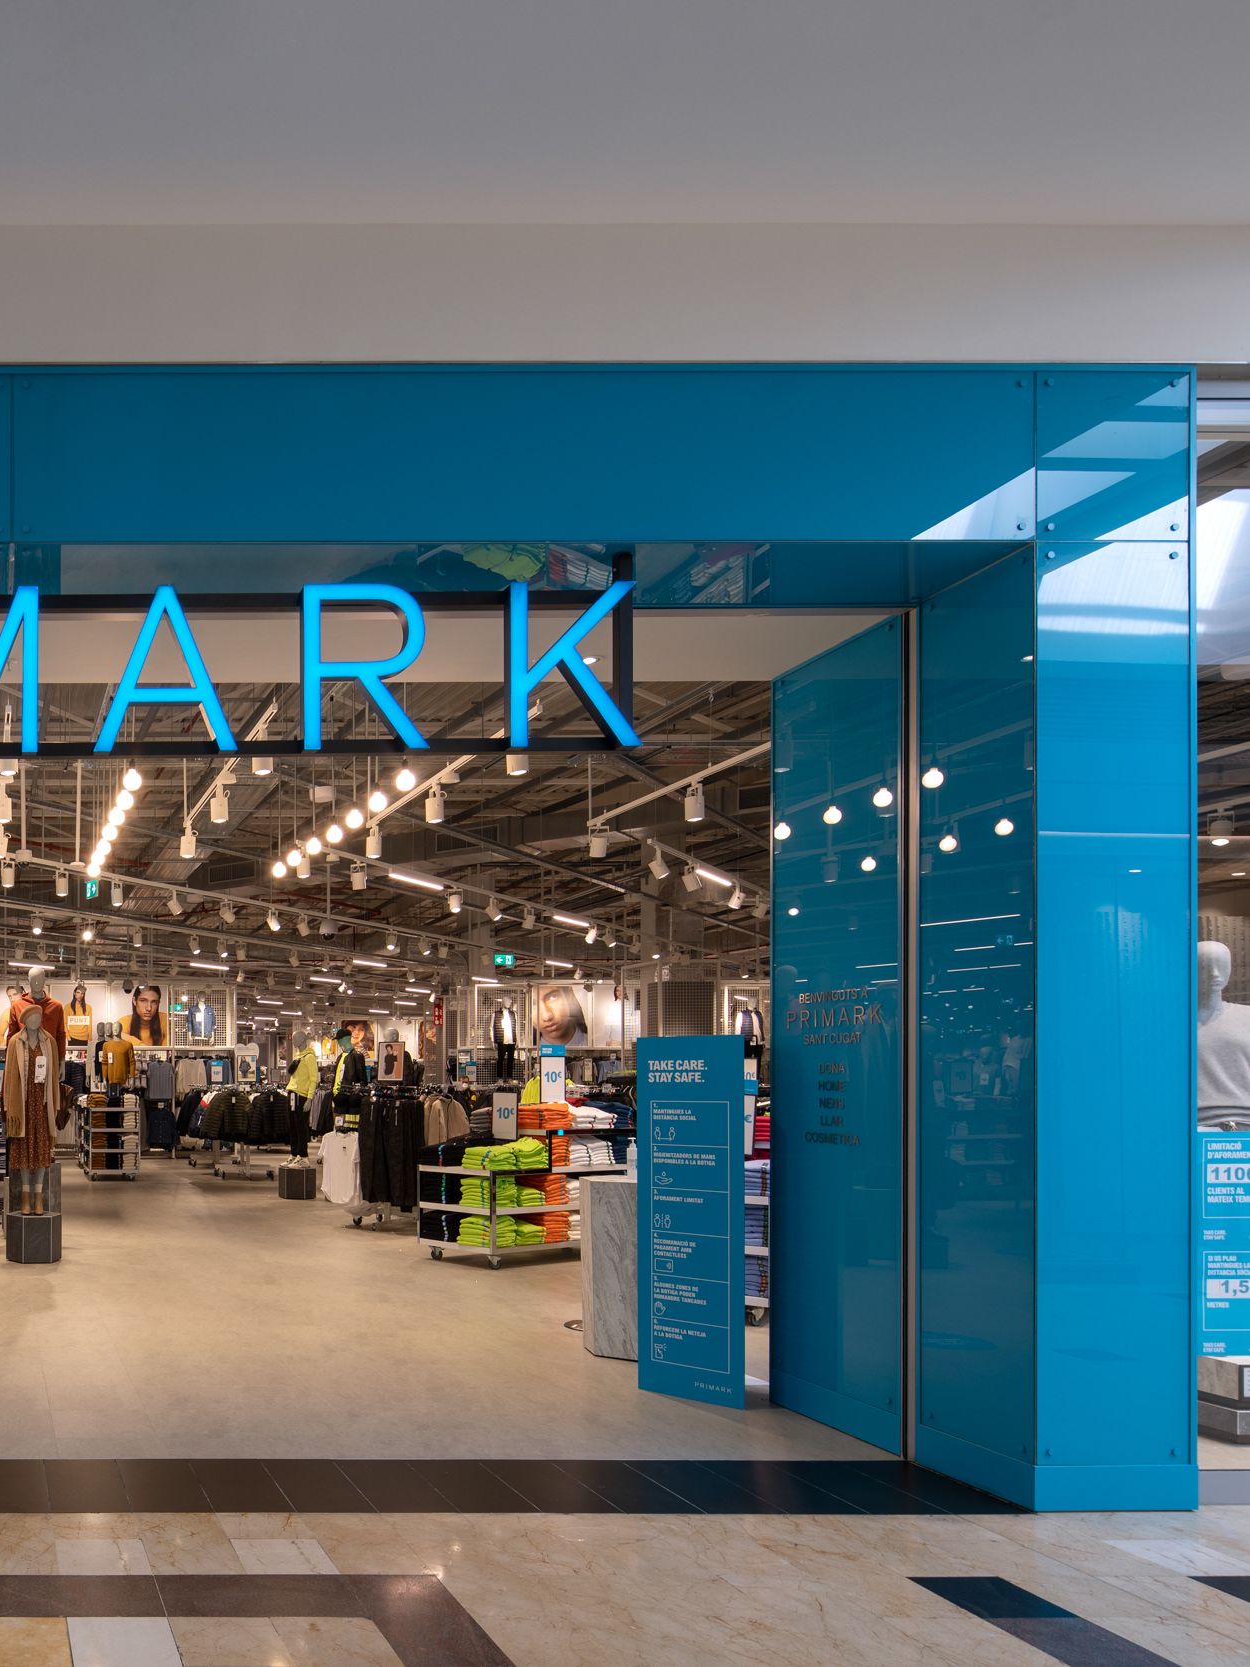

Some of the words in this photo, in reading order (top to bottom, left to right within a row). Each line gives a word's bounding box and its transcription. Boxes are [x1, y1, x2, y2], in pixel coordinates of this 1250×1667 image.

[798, 988, 858, 1004] BENVINGUTS
[786, 1003, 882, 1030] PRIMARK
[804, 1033, 828, 1045] SANT
[830, 1031, 861, 1044] CUGAT
[648, 1060, 674, 1071] TAKE
[676, 1060, 708, 1071] CARE.
[544, 1071, 562, 1083] 10€
[648, 1072, 673, 1082] STAY
[675, 1072, 705, 1082] SAFE.
[818, 1080, 846, 1092] HOME
[496, 1107, 515, 1119] 10€
[1207, 1141, 1242, 1150] LIMITACIÓ
[1207, 1187, 1235, 1195] CLIENTS
[1236, 1187, 1245, 1195] AL
[1207, 1195, 1234, 1203] MATEIX
[653, 1250, 687, 1259] CONTACTLESS
[1221, 1280, 1250, 1297] 1,5
[694, 1381, 733, 1394] PRIMARK
